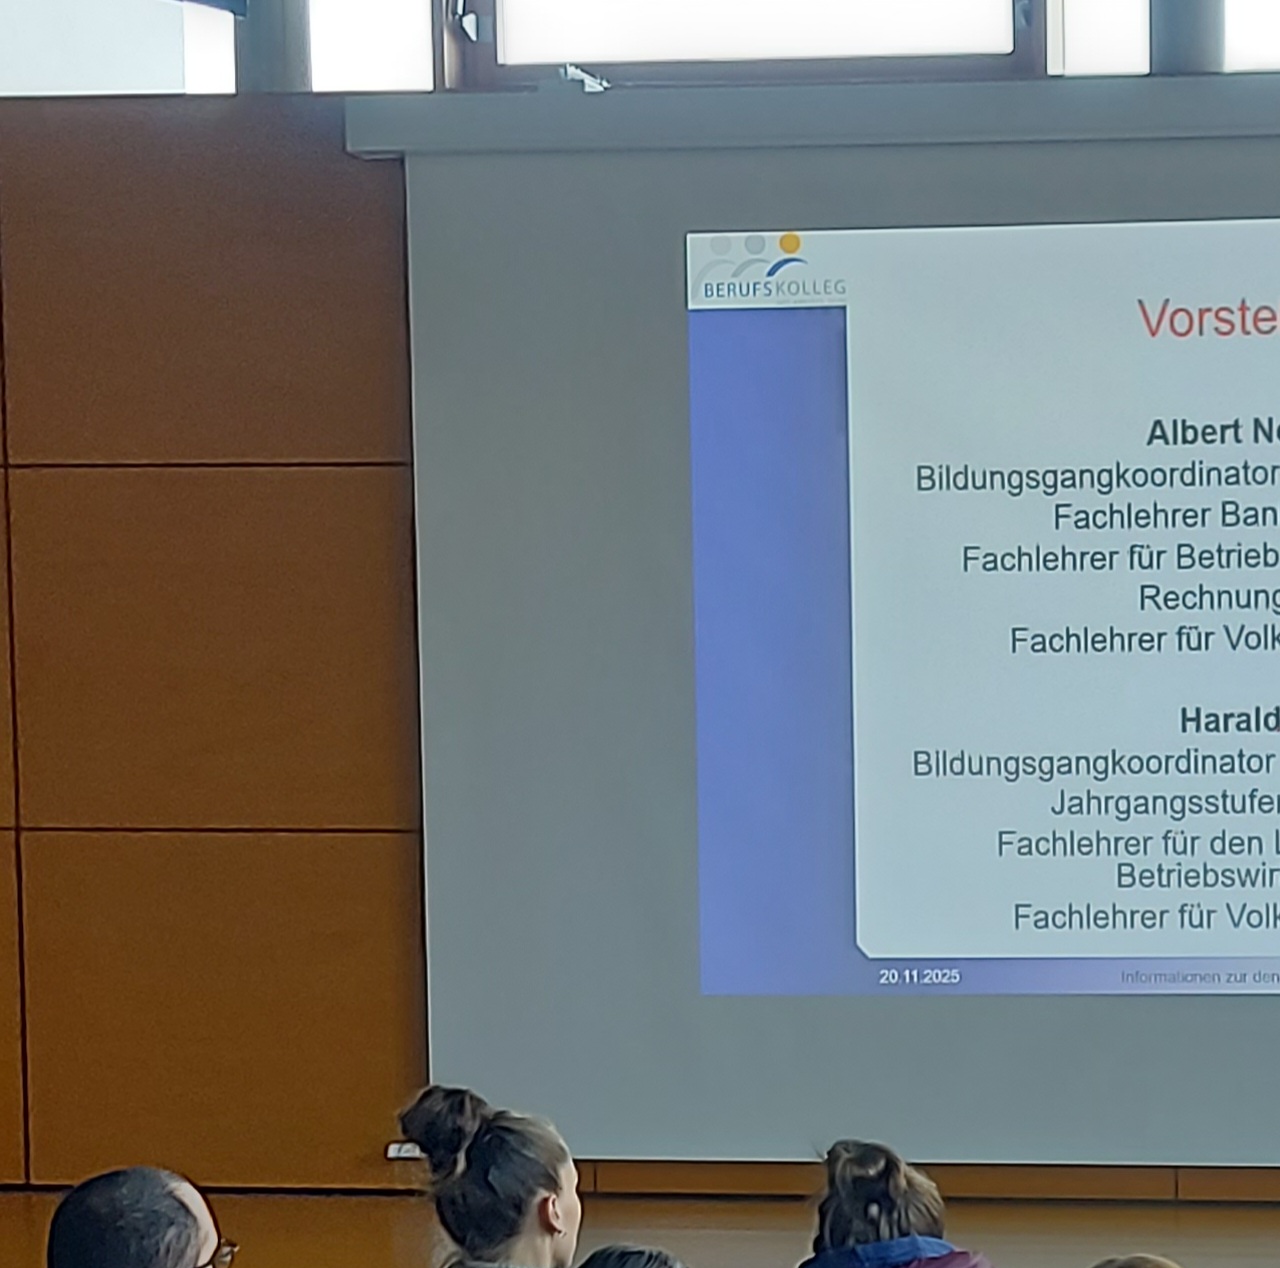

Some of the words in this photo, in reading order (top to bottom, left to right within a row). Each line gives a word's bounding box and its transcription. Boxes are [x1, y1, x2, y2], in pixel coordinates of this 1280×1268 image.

[704, 279, 846, 298] BERUFSKOLLEG
[1147, 418, 1243, 446] Albert
[917, 459, 1280, 497] Bildungsgangkoordinator
[1054, 501, 1211, 530] Fachlehrer
[963, 543, 1119, 573] Fachlehrer
[1128, 543, 1166, 570] für
[1011, 625, 1166, 653] Fachlehrer
[1176, 624, 1214, 651] für
[913, 748, 1275, 783] Bildungsgangkoordinator
[998, 830, 1153, 857] Fachlehrer
[1162, 830, 1200, 856] für
[1210, 830, 1263, 856] den
[1015, 903, 1169, 930] Fachlehrer
[1179, 903, 1217, 928] für
[880, 969, 960, 985] 20.11.2025
[1121, 970, 1221, 984] Informationen
[1226, 972, 1247, 983] zur
[1253, 969, 1280, 983] den
